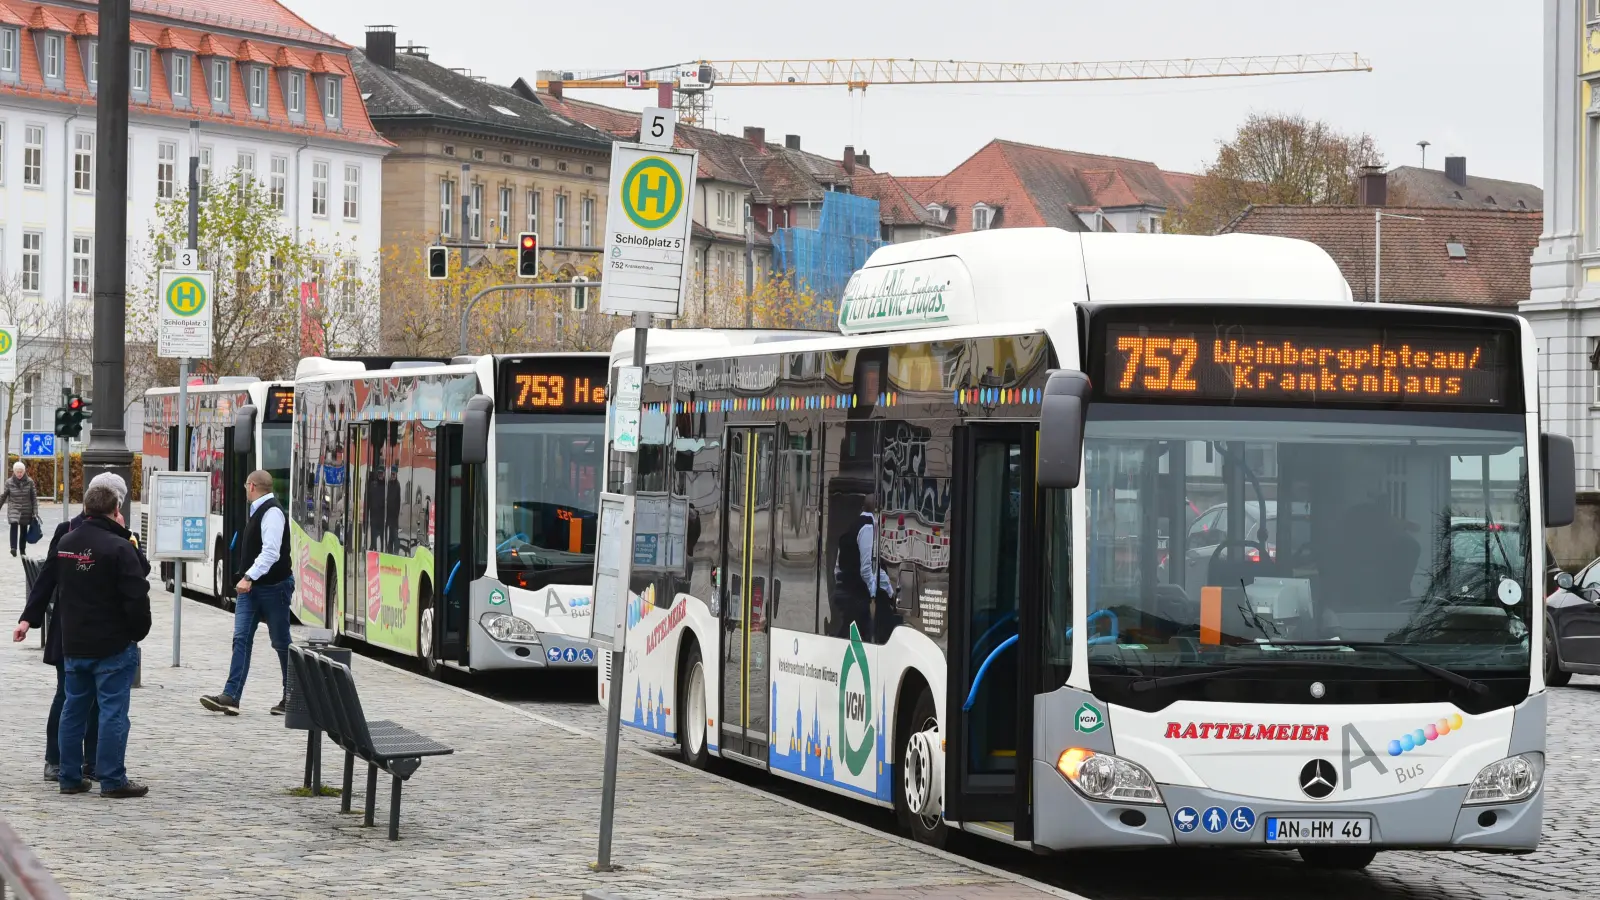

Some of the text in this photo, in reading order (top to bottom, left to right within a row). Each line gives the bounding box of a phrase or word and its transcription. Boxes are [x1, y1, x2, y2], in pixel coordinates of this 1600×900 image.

[651, 115, 665, 138] 5
[637, 173, 668, 214] H
[615, 233, 681, 249] Schloßplatz 5
[182, 253, 191, 266] 3
[611, 261, 624, 270] 752
[177, 286, 195, 307] H
[164, 319, 201, 328] Schloßplatz
[1118, 336, 1198, 391] 752
[1213, 339, 1481, 370] Weinbergplateau/
[516, 375, 563, 407] 753
[1234, 365, 1462, 394] Krankenhaus
[544, 587, 568, 617] A
[571, 609, 591, 619] Bus
[646, 597, 687, 656] RATTELMEIER
[845, 690, 865, 722] VGN
[1079, 715, 1096, 724] VGN
[1163, 721, 1331, 742] RATTELMEIER
[1341, 722, 1389, 792] A
[1395, 762, 1425, 785] Bus
[1277, 820, 1300, 838] AN
[1311, 820, 1334, 838] HM
[1341, 820, 1362, 838] 46
